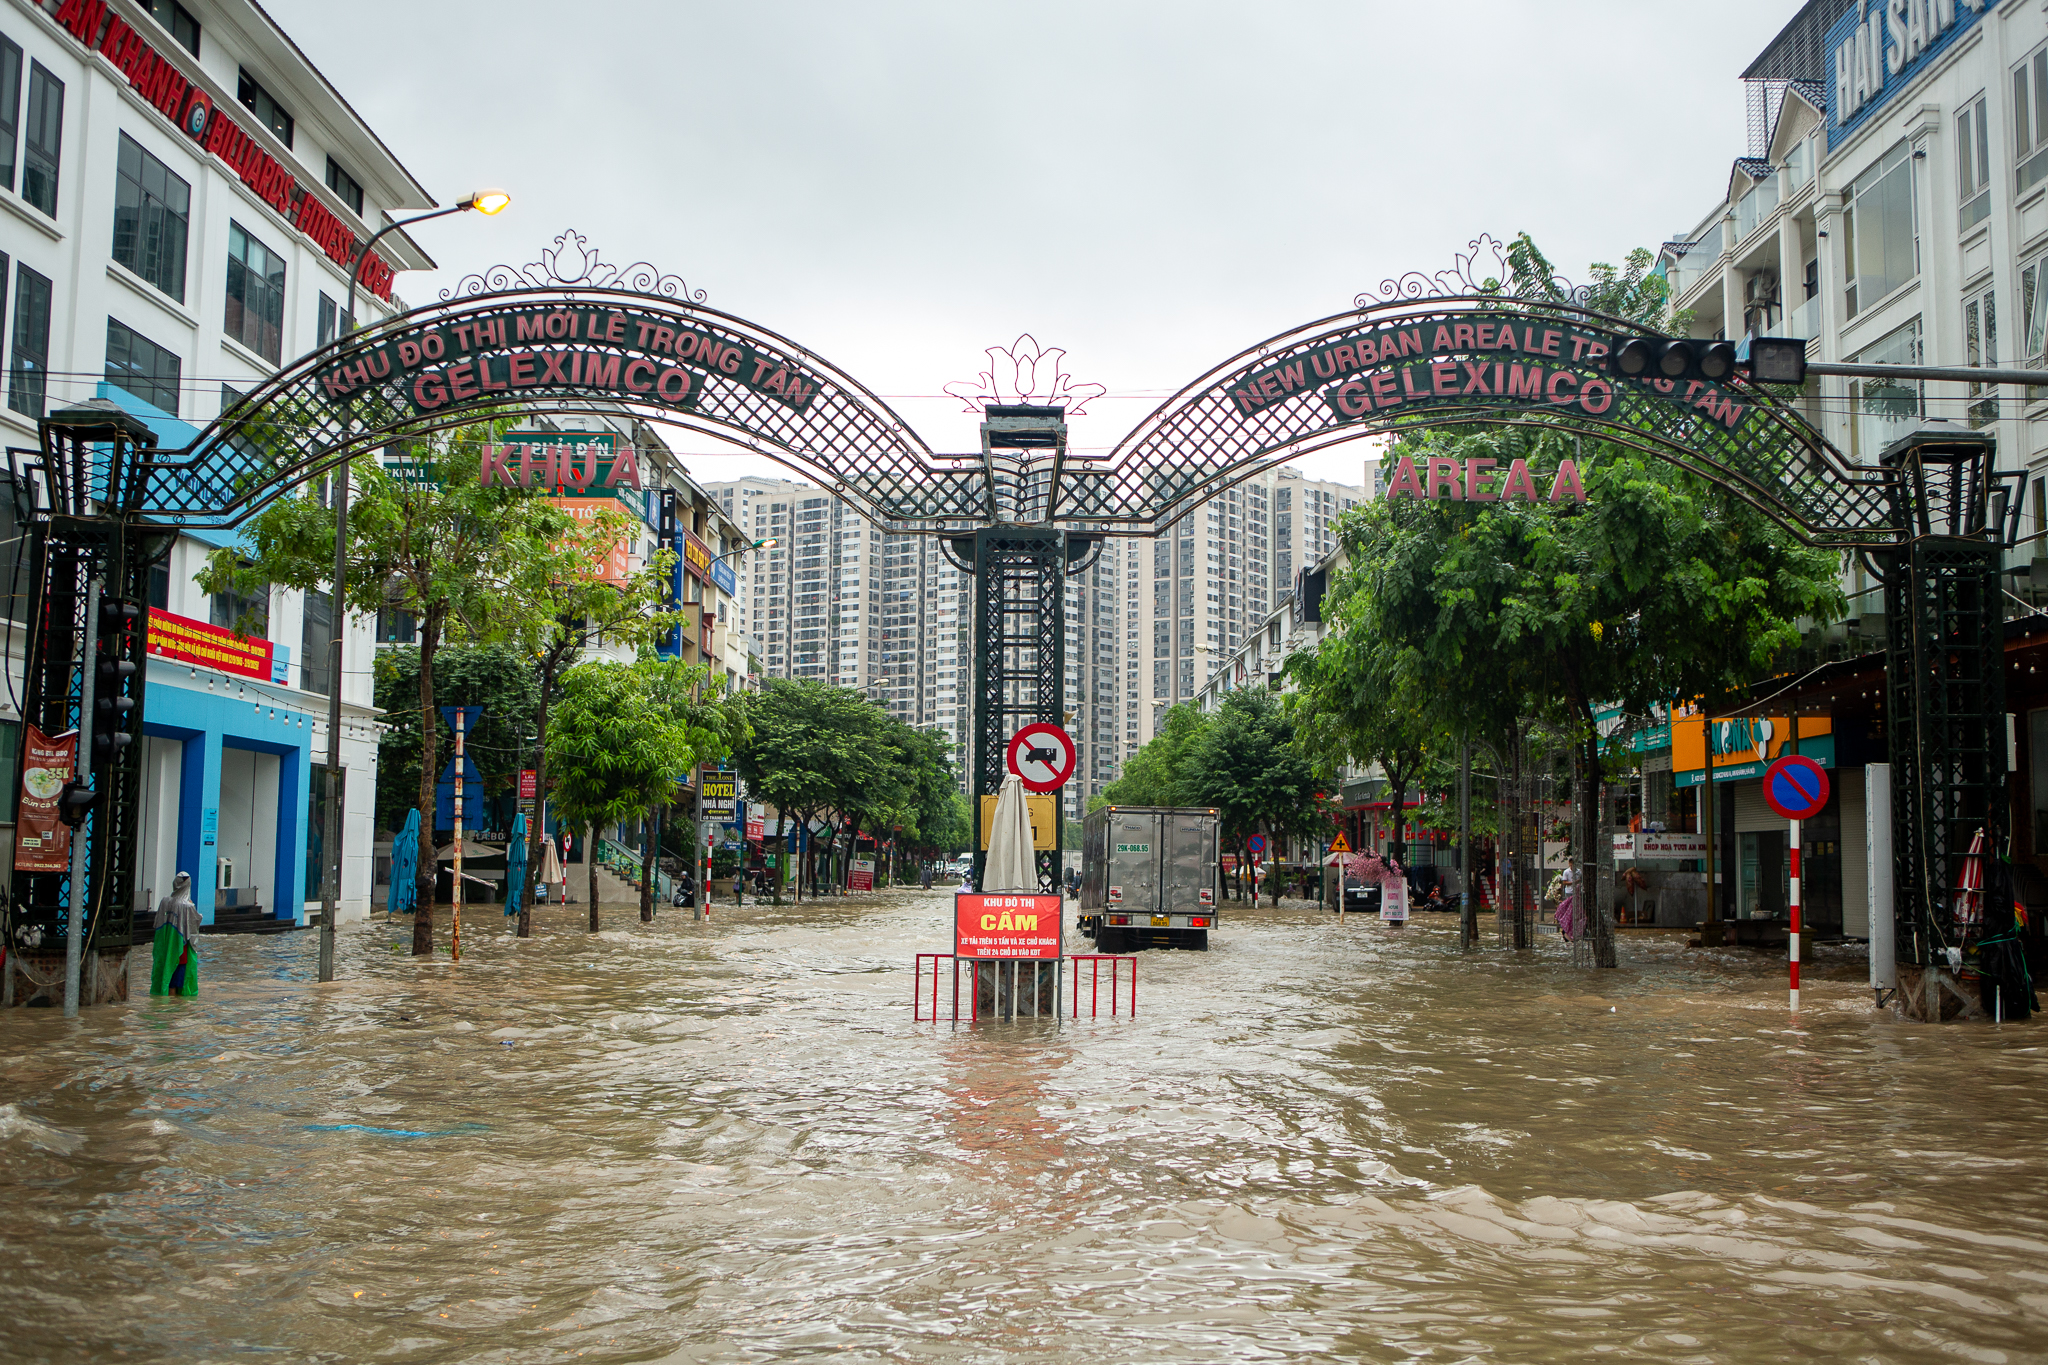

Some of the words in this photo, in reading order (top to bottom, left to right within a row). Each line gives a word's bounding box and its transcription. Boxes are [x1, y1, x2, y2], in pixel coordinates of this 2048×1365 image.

[99, 13, 188, 120] KHANH
[205, 110, 295, 213] BILLIARDS
[295, 191, 355, 266] FITNESS
[322, 350, 391, 399] KHU
[398, 330, 445, 368] ĐÔ
[451, 318, 507, 348] THỊ
[516, 309, 579, 342] MỚI
[586, 312, 628, 343] LÊ
[635, 320, 742, 374] TRỌNG
[749, 356, 814, 408] TẤN
[413, 351, 691, 409] GELEXIMCO
[1235, 360, 1306, 413] NEW
[1310, 328, 1424, 379] URBAN
[1432, 323, 1518, 351] AREA
[1523, 326, 1562, 358] LE
[1683, 379, 1743, 429] TAN
[1336, 361, 1613, 417] GELEXIMCO
[481, 445, 597, 489] KHU
[602, 446, 642, 491] A
[1386, 456, 1538, 502] AREA
[1549, 459, 1587, 502] A
[48, 767, 70, 779] 35K
[703, 783, 735, 796] HOTEL
[703, 797, 716, 809] NHÀ
[1117, 844, 1149, 853] 29K-068.95
[984, 898, 1003, 907] KHU
[1005, 896, 1018, 907] ĐÔ
[1020, 898, 1035, 910] THỊ
[980, 908, 1038, 931] CẤM
[977, 947, 991, 956] TRÊN
[1019, 947, 1029, 956] VÀO
[979, 936, 993, 945] TRÊN
[999, 936, 1010, 945] TẤN
[1039, 936, 1056, 945] KHÁCH
